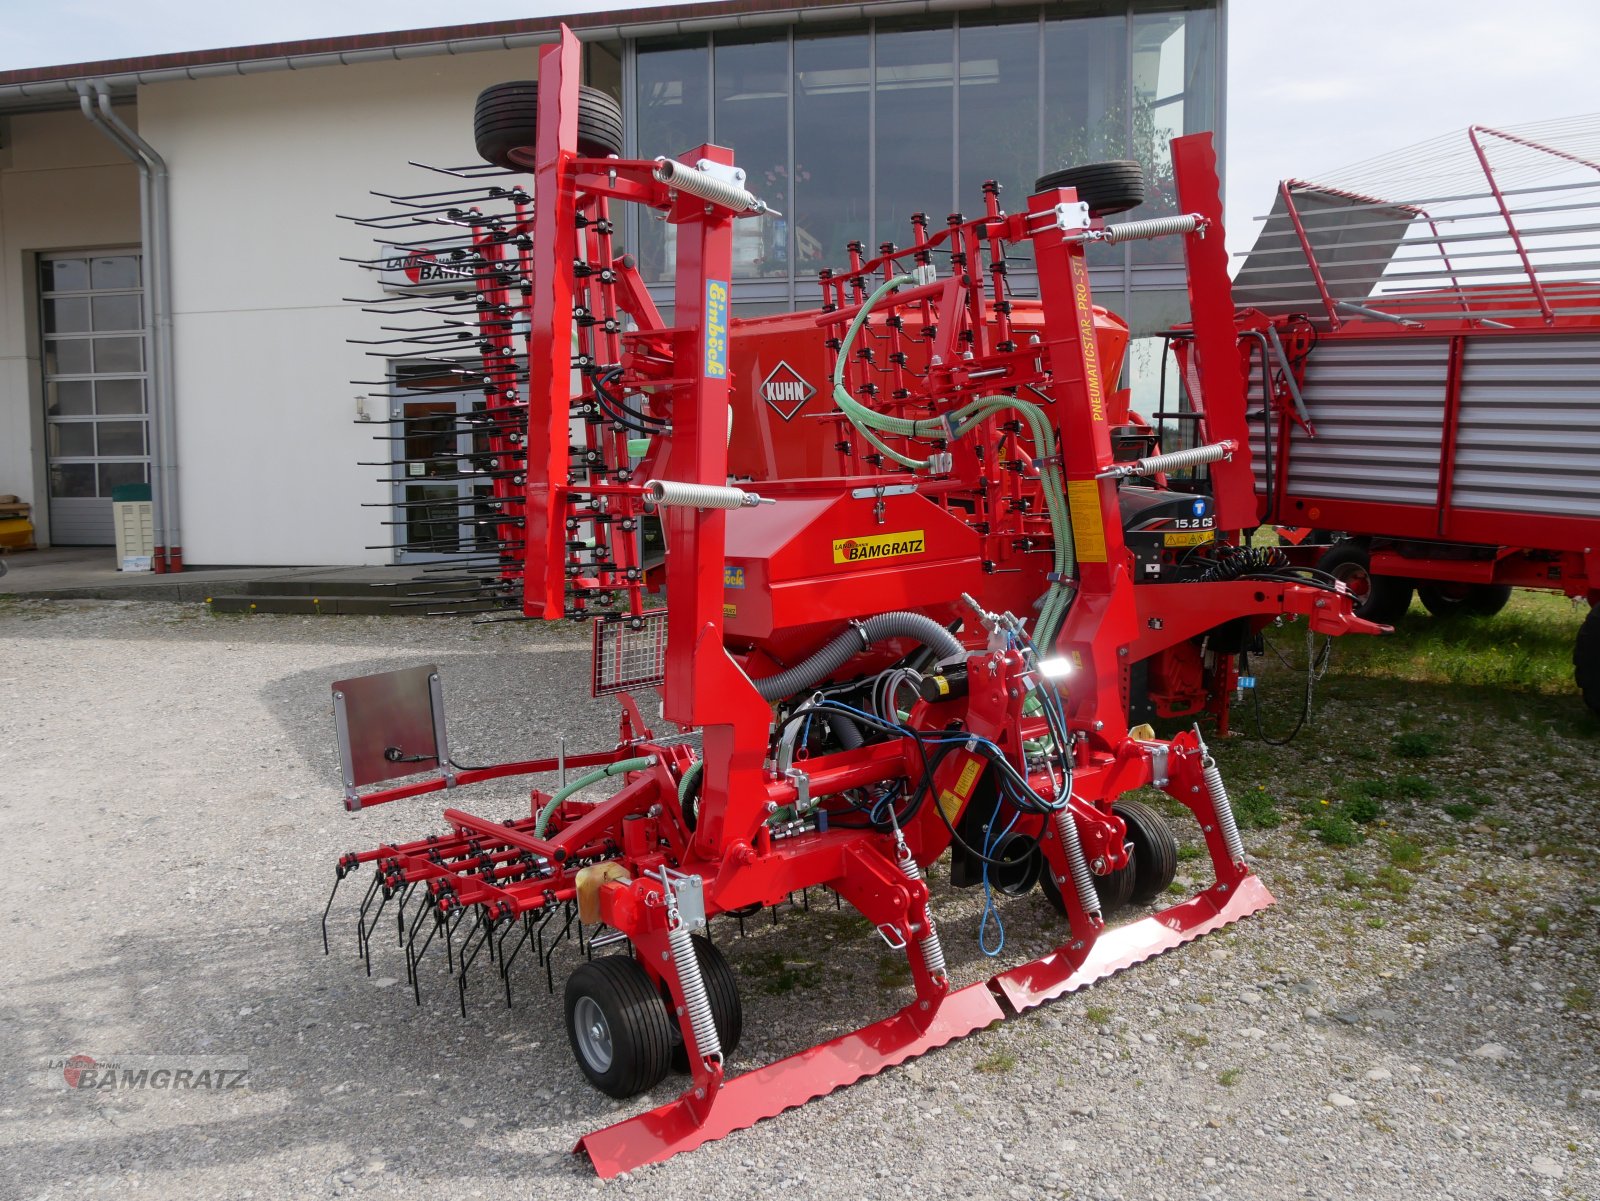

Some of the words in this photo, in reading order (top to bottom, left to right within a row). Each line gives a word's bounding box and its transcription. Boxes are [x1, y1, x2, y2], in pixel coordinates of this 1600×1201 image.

[708, 283, 726, 375] Einböck
[766, 382, 805, 400] KUHN
[1175, 519, 1200, 528] 15.2
[849, 540, 923, 560] BAMGRATZ
